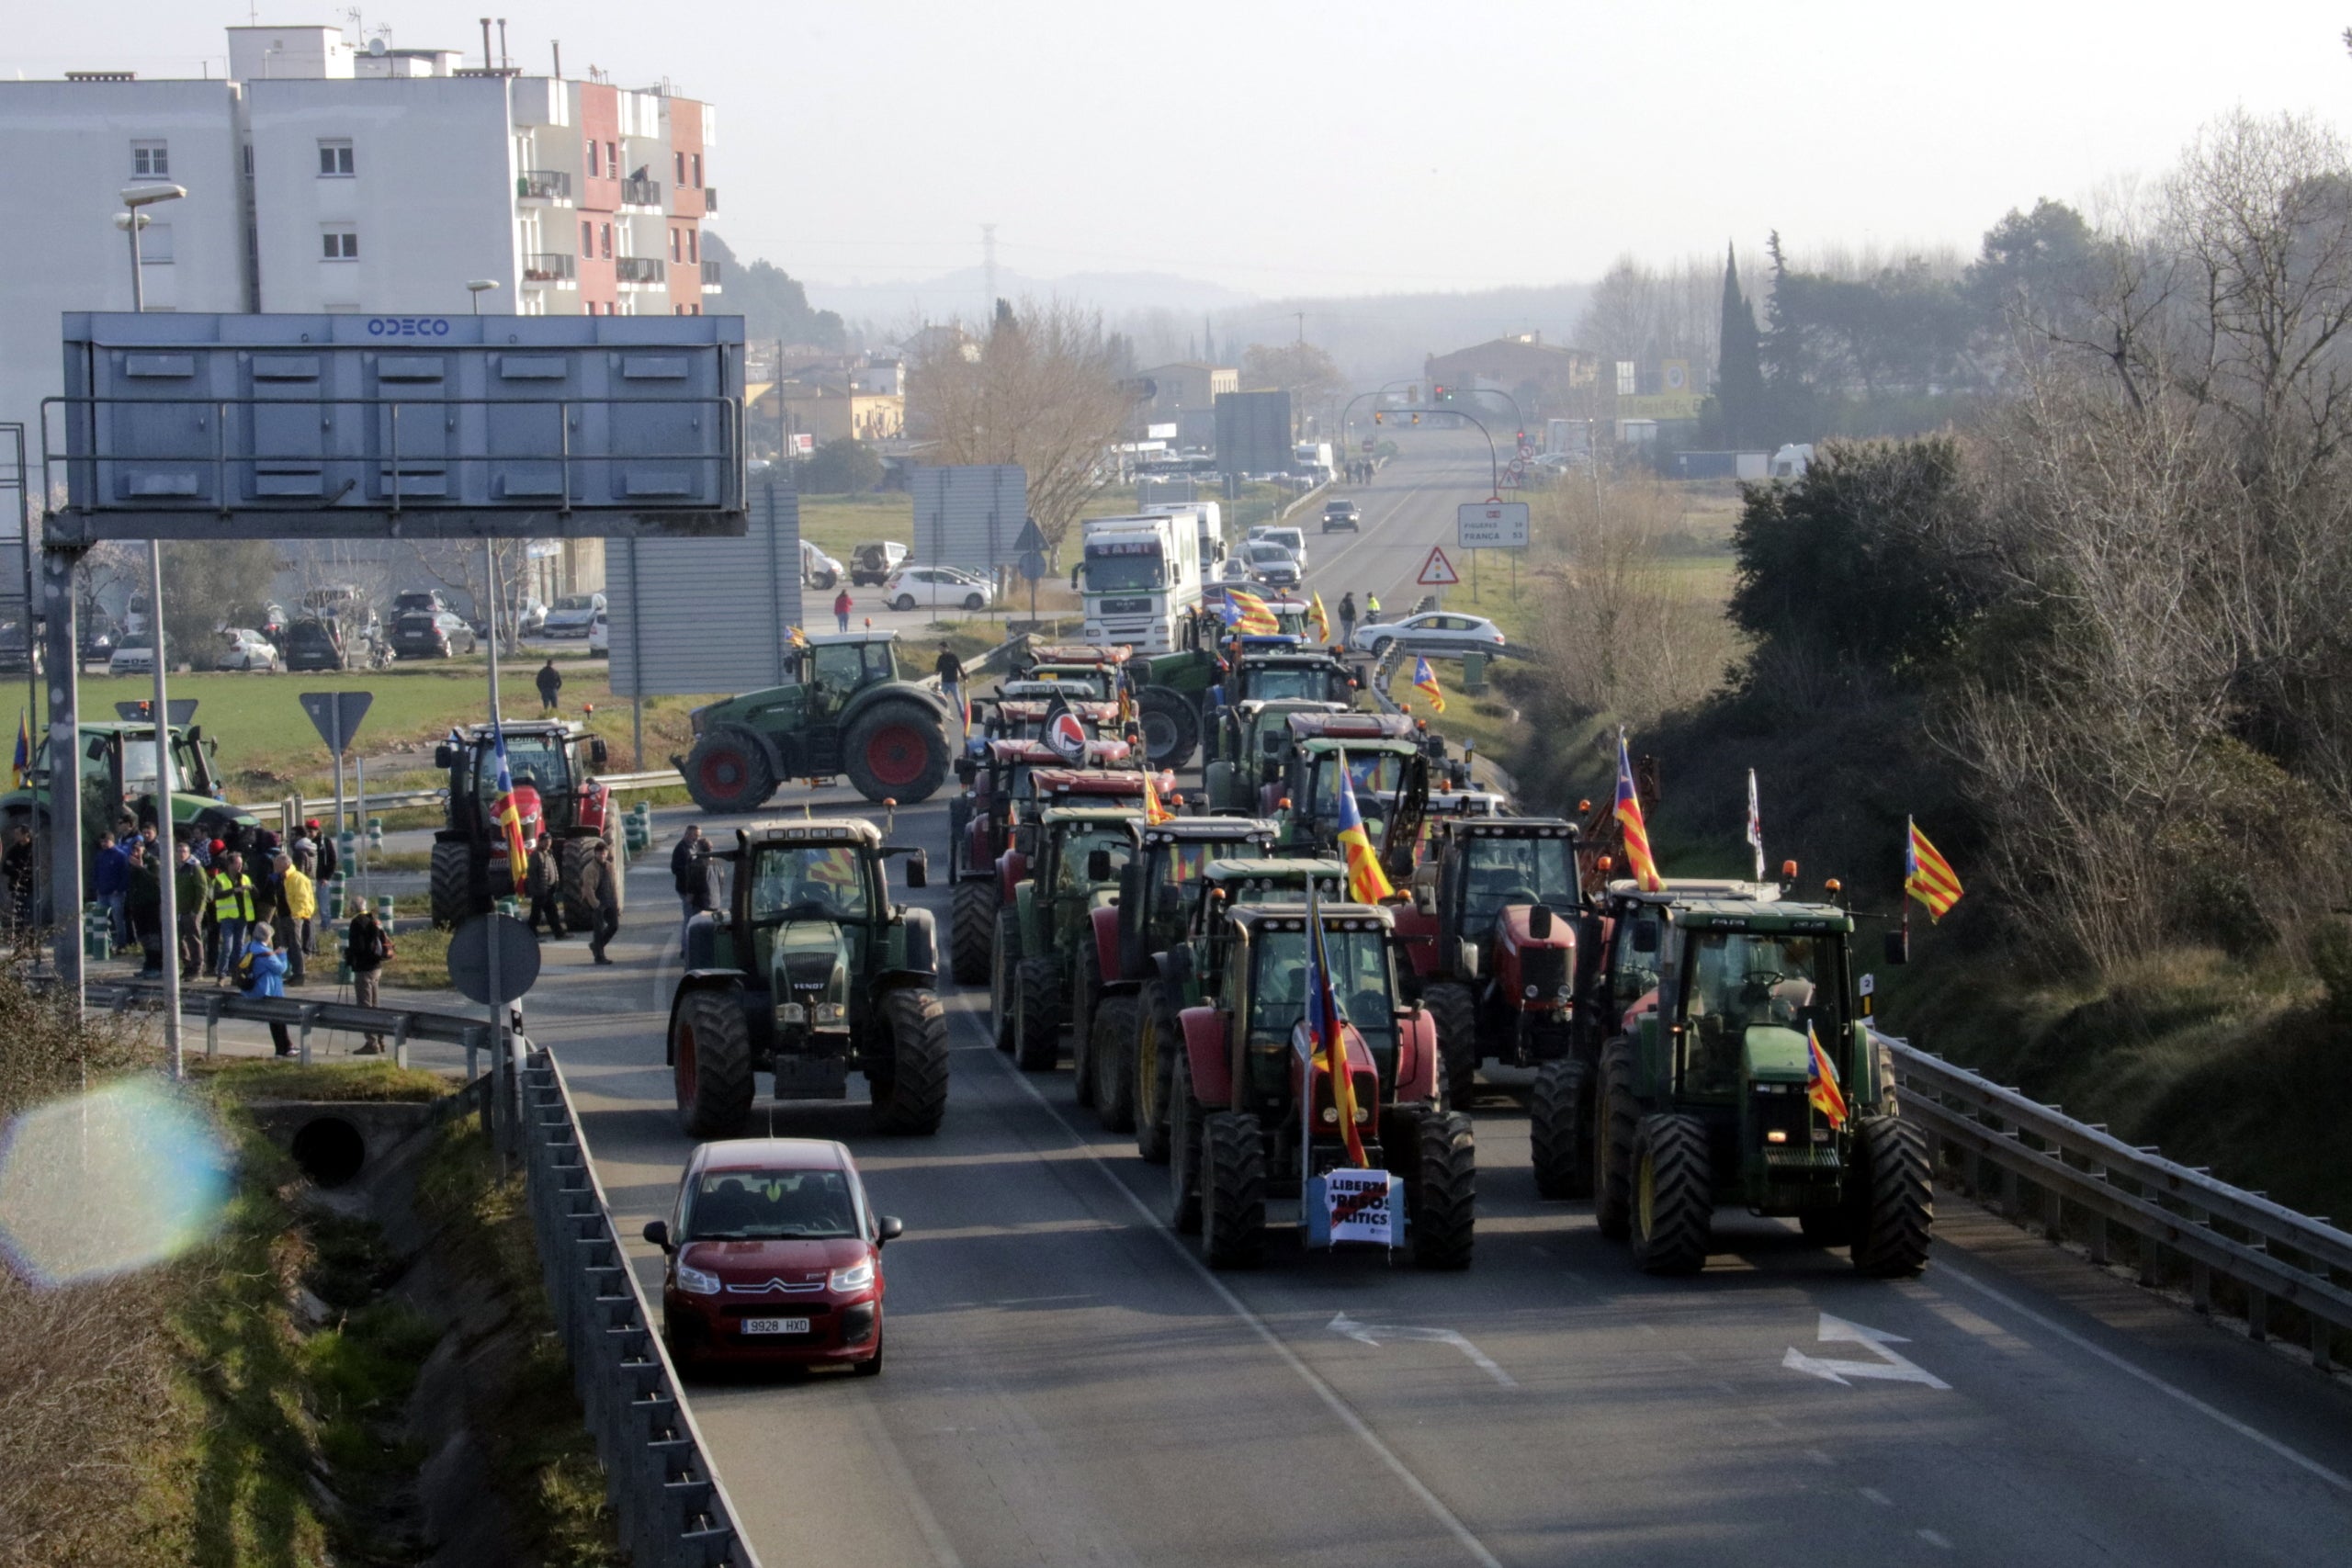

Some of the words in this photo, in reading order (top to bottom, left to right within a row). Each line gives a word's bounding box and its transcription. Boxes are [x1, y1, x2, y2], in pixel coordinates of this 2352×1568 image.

[368, 319, 449, 336] ODECO
[1464, 533, 1500, 541] FRANÇA
[1097, 542, 1150, 556] SAMI
[1864, 979, 1871, 987] 2
[751, 1320, 779, 1332] 9928
[786, 1319, 807, 1331] HXD
